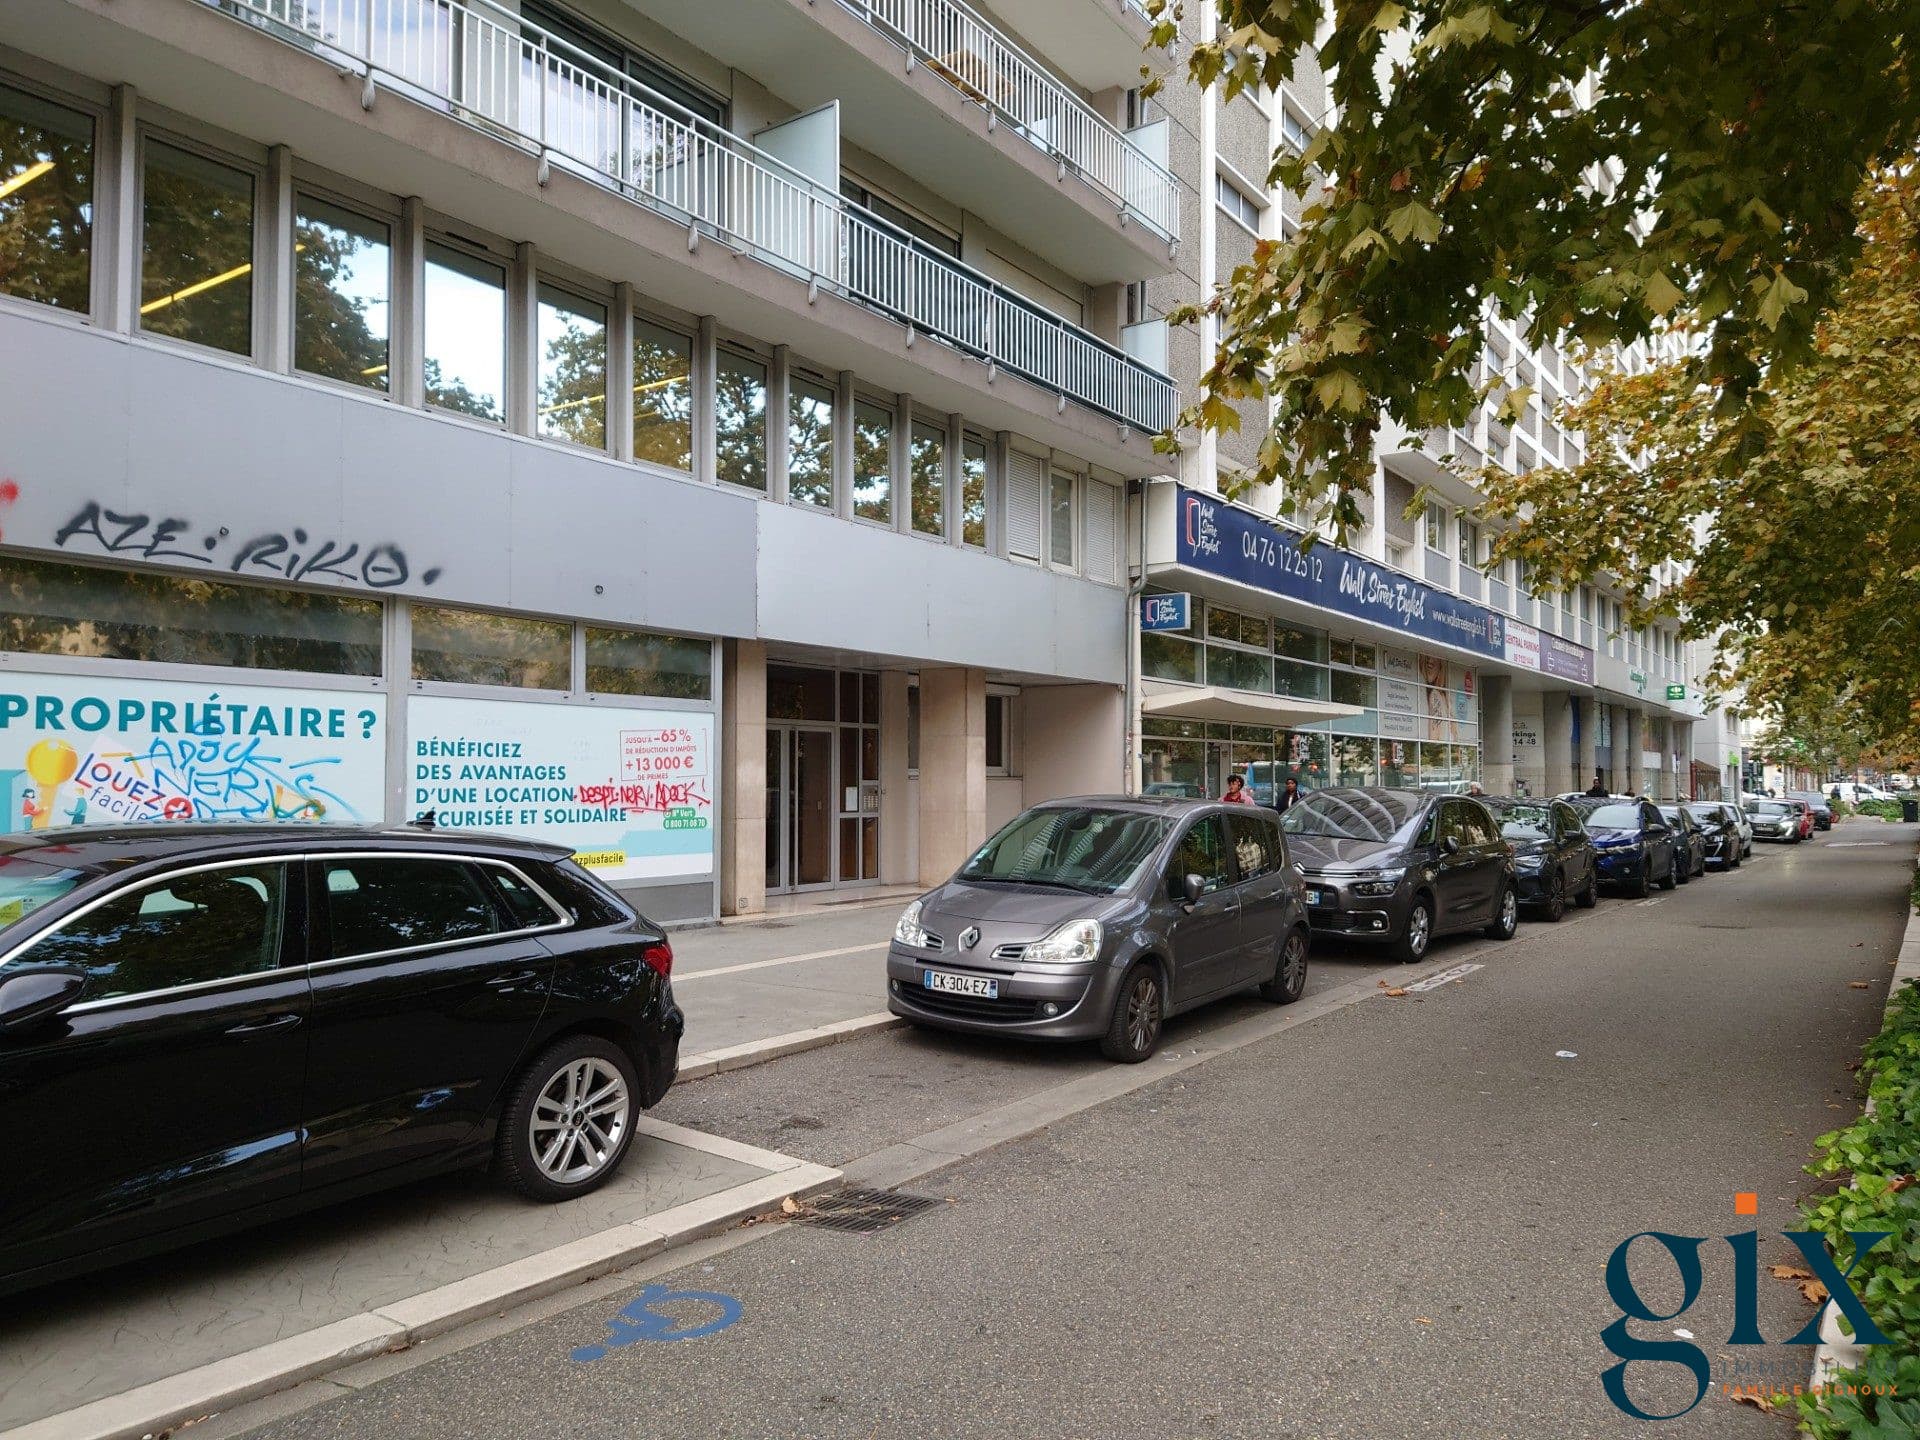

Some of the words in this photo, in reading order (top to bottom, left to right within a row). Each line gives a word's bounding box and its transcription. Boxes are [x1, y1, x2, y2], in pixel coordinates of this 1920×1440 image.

[1243, 531, 1257, 560] 04
[1261, 537, 1275, 566] 76
[1280, 544, 1291, 572] 12
[1311, 556, 1323, 583] 12
[1339, 560, 1366, 604] Wall
[1367, 572, 1396, 610] Street
[1396, 584, 1426, 626] English
[0, 693, 345, 738] PROPRIÉTAIRE
[416, 736, 522, 758] BÉNÉFICIEZ
[416, 764, 451, 781] DES
[460, 764, 567, 781] AVANTAGES
[655, 756, 681, 770] 000
[684, 755, 694, 768] €
[75, 753, 168, 811] LOUEZ
[90, 786, 148, 820] facile
[485, 786, 574, 803] LOCATION
[416, 806, 514, 828] SCURISÉE
[520, 808, 537, 824] ET
[544, 807, 627, 825] SOLIDAIRE
[574, 853, 624, 867] ezplusfacile
[933, 974, 987, 995] CK-304-EZ
